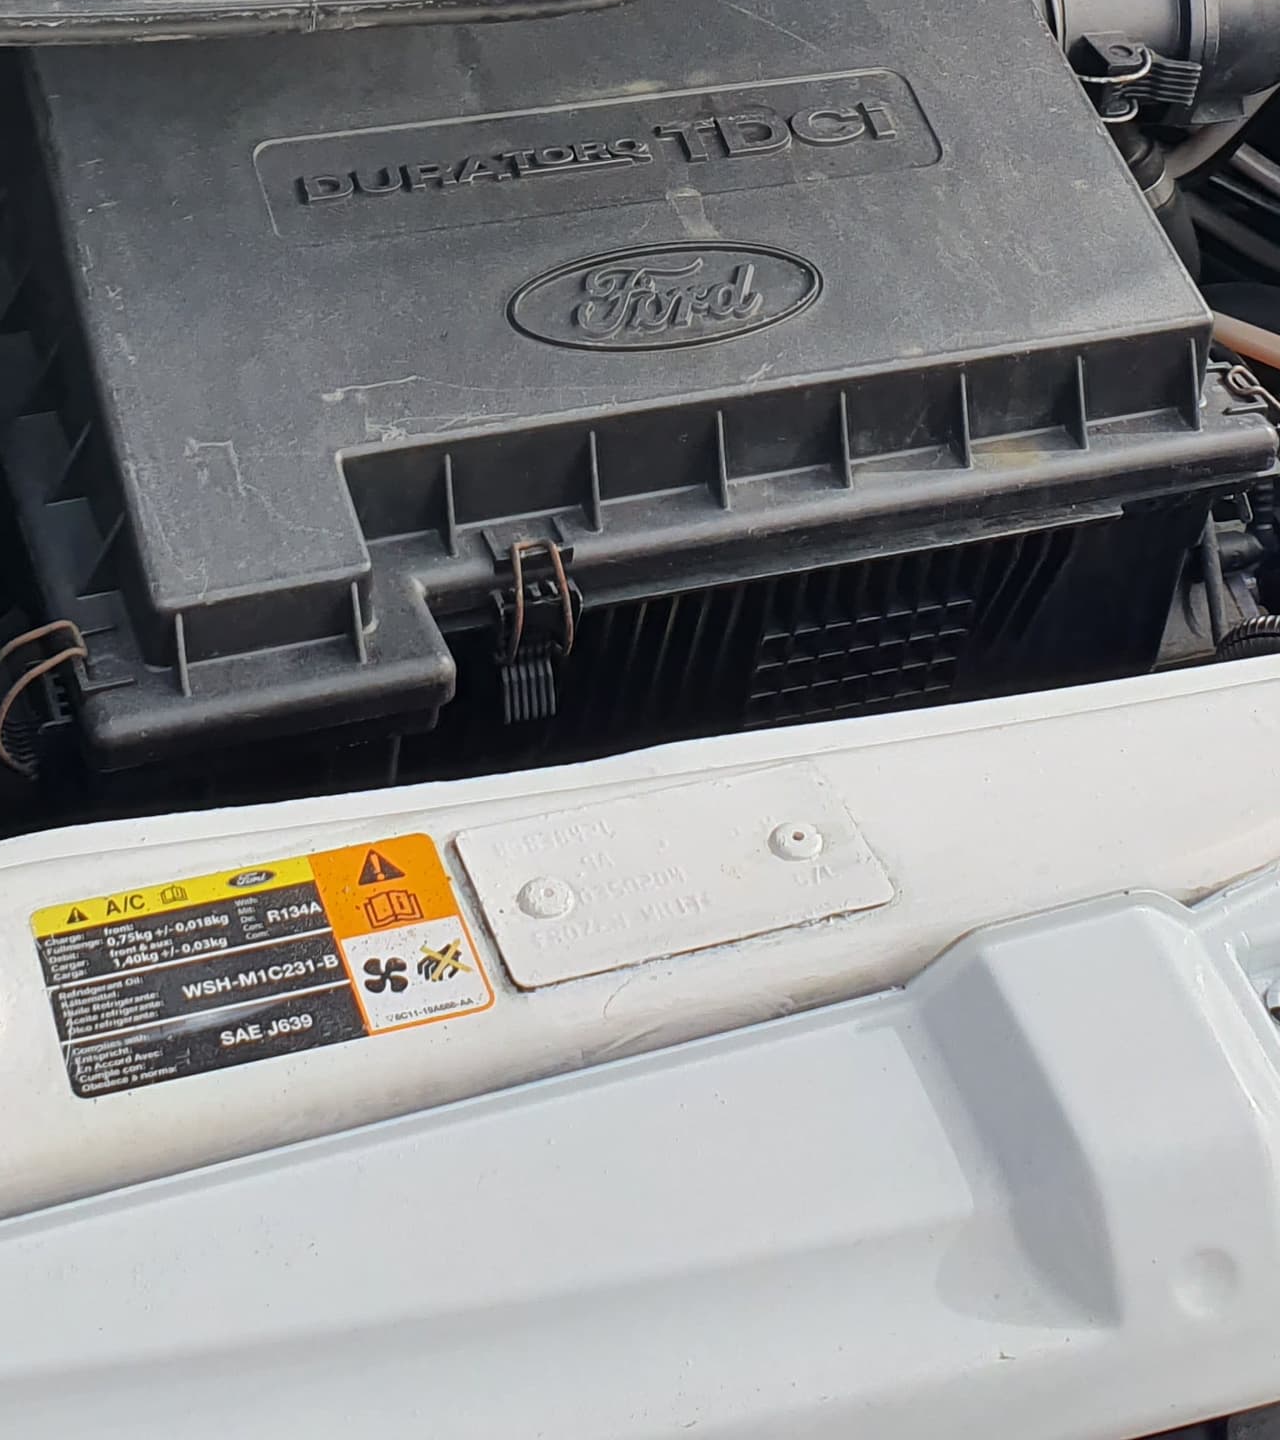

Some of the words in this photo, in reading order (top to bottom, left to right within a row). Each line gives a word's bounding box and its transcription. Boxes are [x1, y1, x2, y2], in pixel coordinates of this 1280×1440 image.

[573, 257, 764, 340] Ford
[106, 894, 146, 917] A/C
[266, 900, 323, 923] R134A
[103, 923, 134, 936] front:
[107, 930, 153, 947] 0,75kg
[175, 913, 230, 933] 0,018kg
[109, 946, 137, 958] front
[112, 951, 160, 969] 1,40kg
[181, 936, 228, 954] 0,03kg
[182, 954, 340, 1000] WSH-M1C231-B
[220, 1024, 263, 1047] SAE
[267, 1013, 314, 1037] J639
